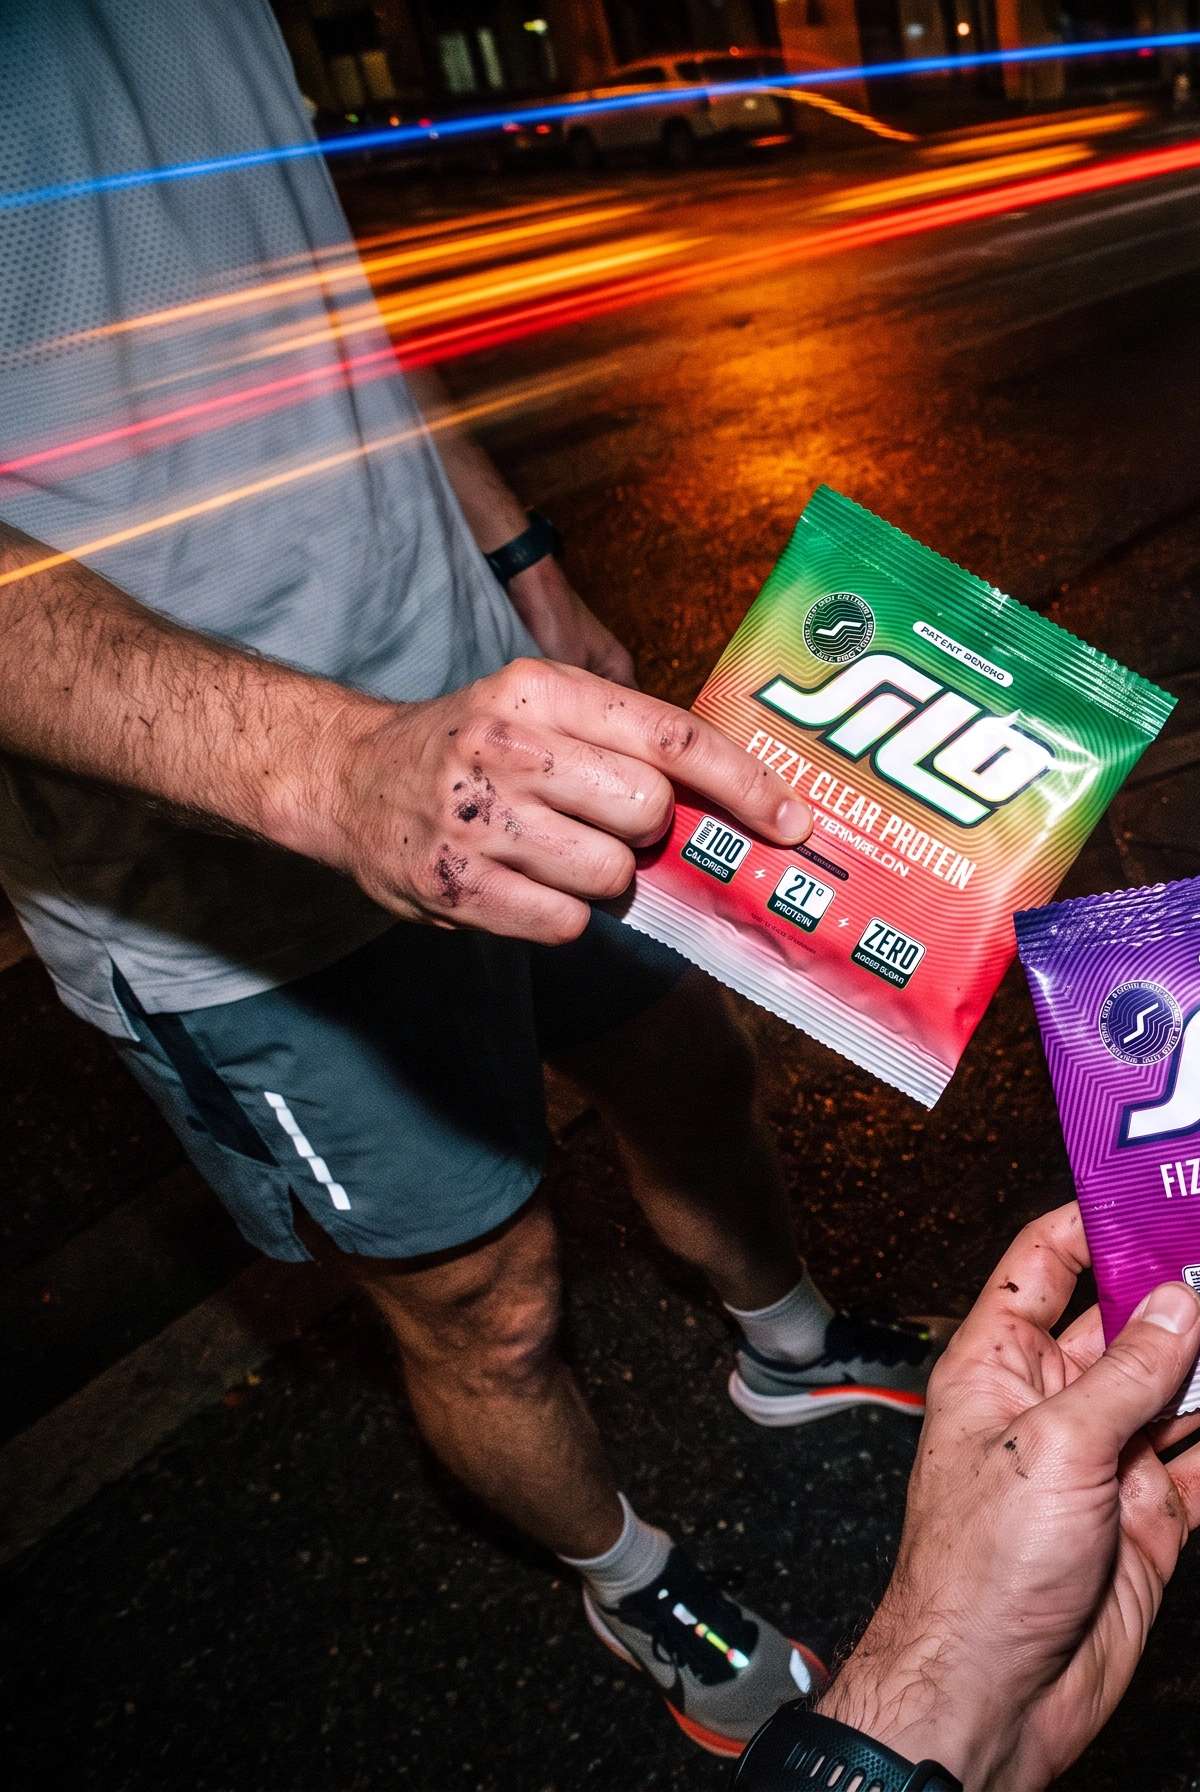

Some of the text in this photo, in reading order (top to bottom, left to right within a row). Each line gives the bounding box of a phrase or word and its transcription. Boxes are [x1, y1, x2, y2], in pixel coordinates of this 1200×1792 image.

[745, 729, 813, 788] FIZZY
[808, 771, 882, 833] CLEAR
[879, 814, 977, 890] PROTEIN
[705, 826, 745, 864] 100
[863, 923, 919, 970] ZERO
